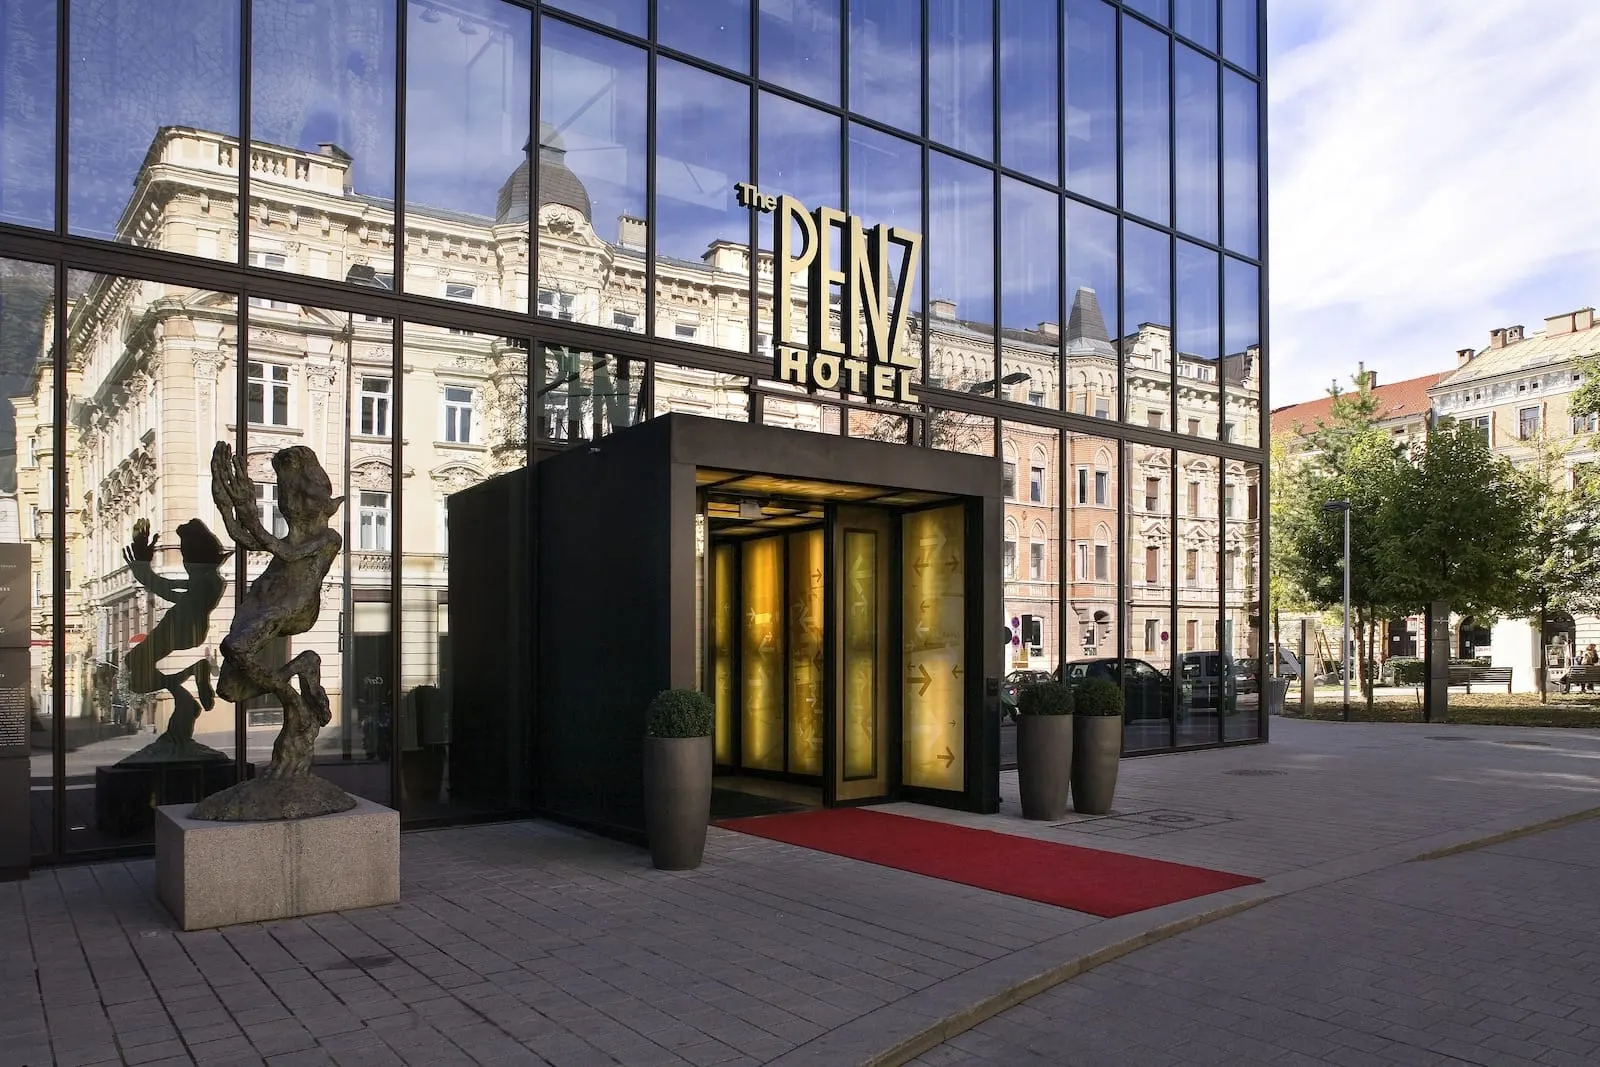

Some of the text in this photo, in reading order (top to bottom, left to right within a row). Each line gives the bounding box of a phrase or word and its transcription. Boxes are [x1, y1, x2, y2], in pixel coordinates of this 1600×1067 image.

[736, 182, 777, 212] The
[779, 194, 923, 368] PENZ
[777, 345, 919, 403] HOTEL
